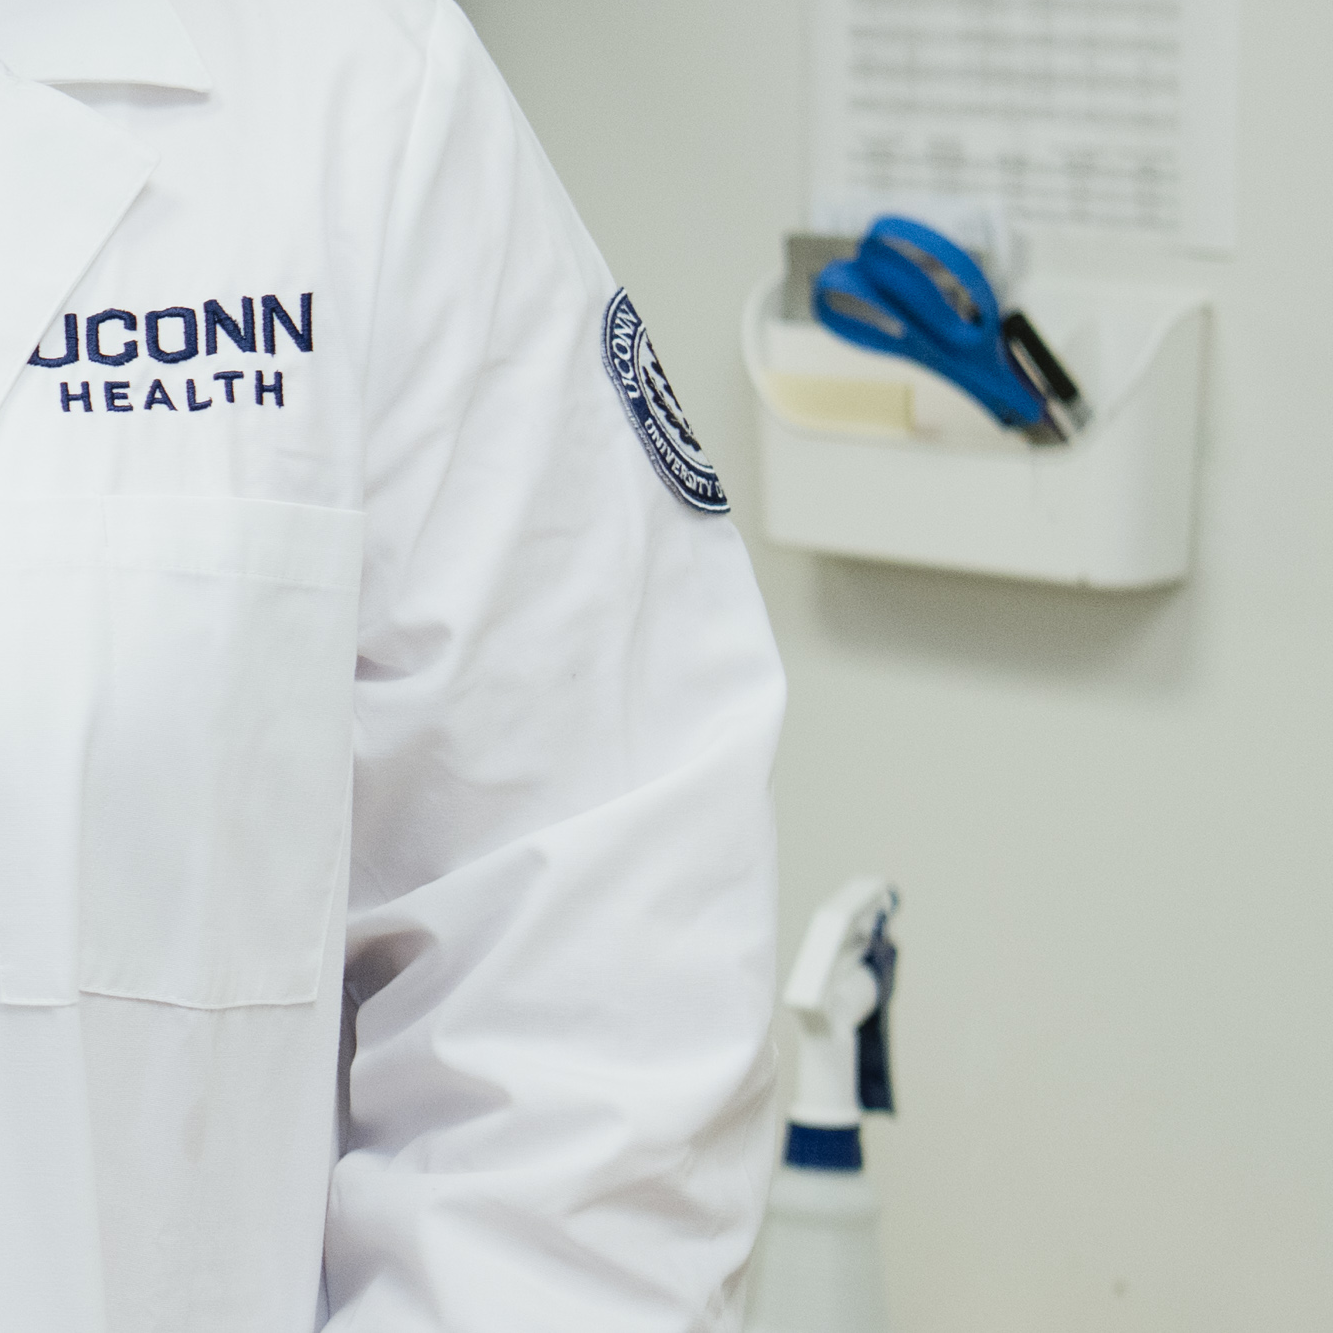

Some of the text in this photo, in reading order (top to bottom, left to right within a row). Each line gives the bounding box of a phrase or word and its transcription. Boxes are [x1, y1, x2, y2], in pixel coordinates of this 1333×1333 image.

[27, 292, 314, 368] UCONN
[60, 370, 284, 412] HEALTH
[644, 417, 715, 498] UNIVERSITY
